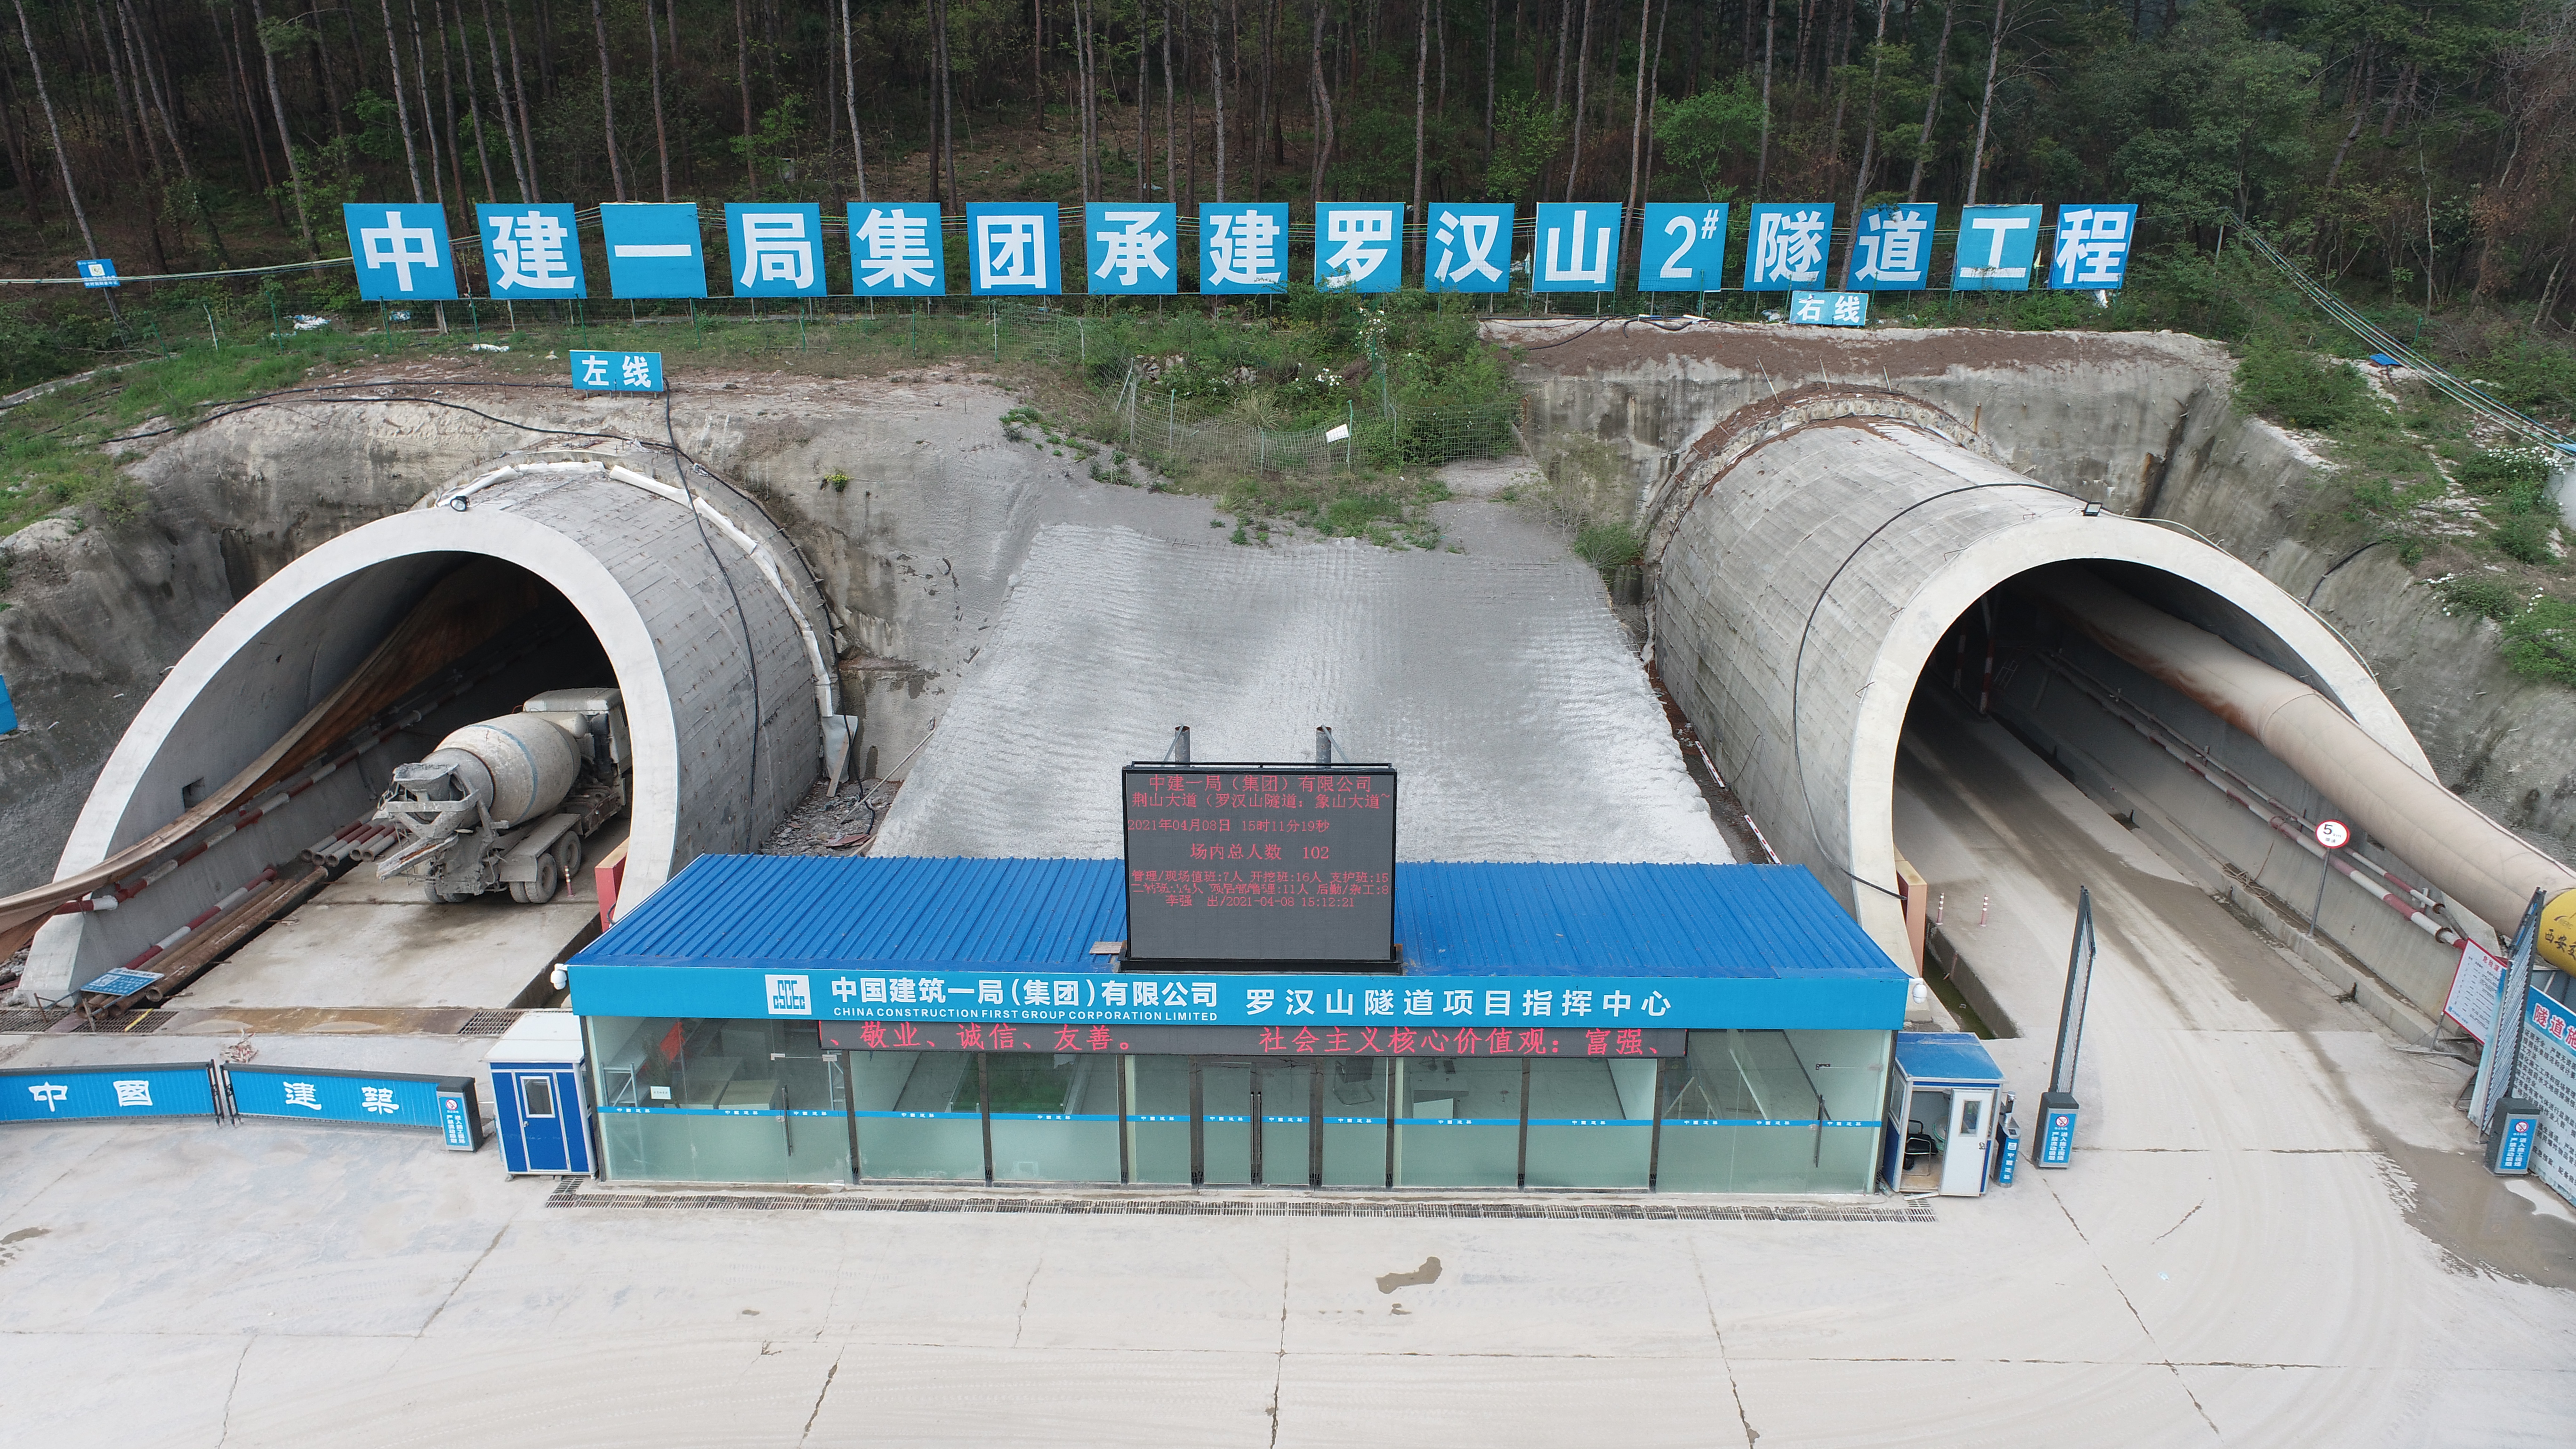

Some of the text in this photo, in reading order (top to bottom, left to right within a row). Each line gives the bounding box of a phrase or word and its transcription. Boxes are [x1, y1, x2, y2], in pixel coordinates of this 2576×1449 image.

[1797, 294, 1860, 323] 右线
[582, 355, 651, 388] 左线
[1128, 819, 1330, 832] 2021年04月08日 15时11分19秒
[1190, 843, 1329, 860] 场内总人数 102
[1166, 894, 1192, 906] 李强
[1302, 897, 1354, 907] 15:12:21
[832, 976, 1671, 1017] 中国建筑一局(集团)有限公司 罗汉山隧道项目指挥中心
[834, 1007, 1217, 1021] CHINA CONSTRUCTION FIRST GROUP CORPORATION LIMITED
[28, 1080, 153, 1112] 中國
[283, 1081, 400, 1115] 建築
